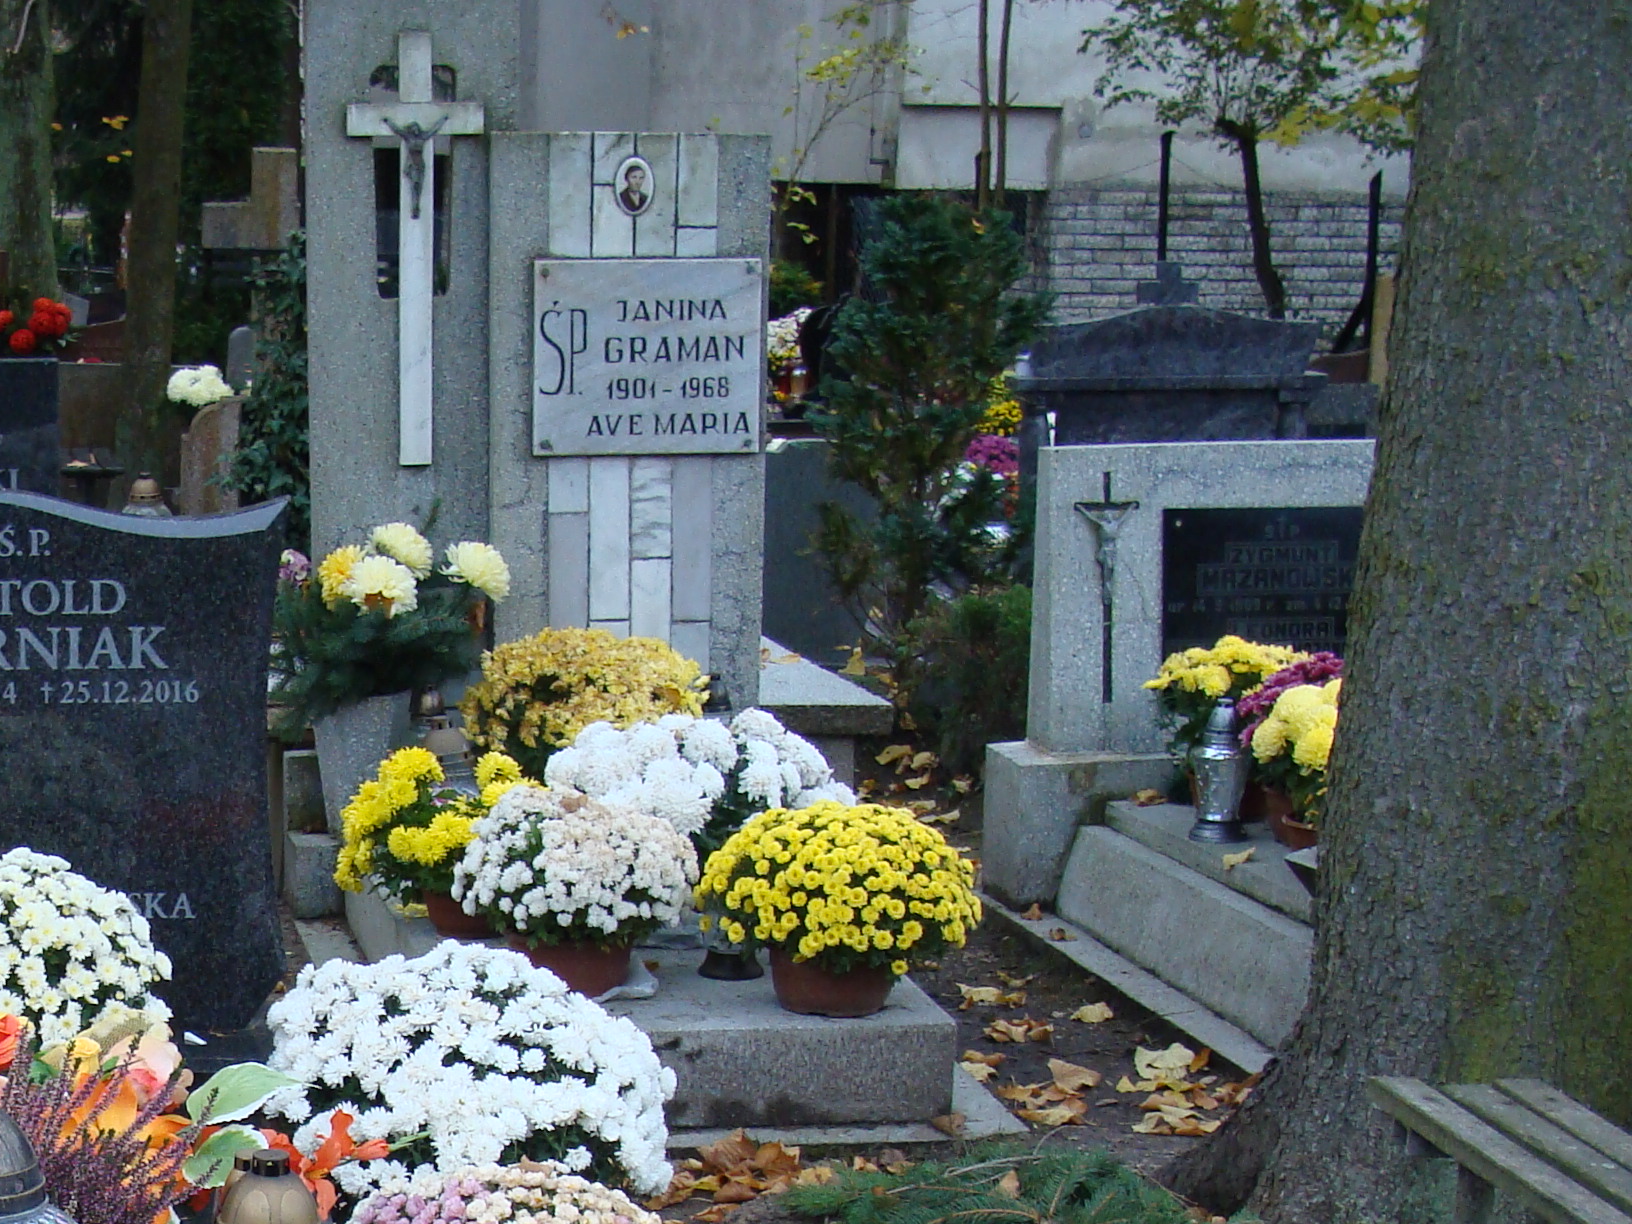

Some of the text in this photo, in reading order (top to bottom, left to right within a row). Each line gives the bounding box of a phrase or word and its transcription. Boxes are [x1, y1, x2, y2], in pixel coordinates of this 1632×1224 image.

[617, 299, 728, 323] JANINA
[604, 336, 745, 364] GRAMAN
[586, 411, 751, 437] AVE MARIA
